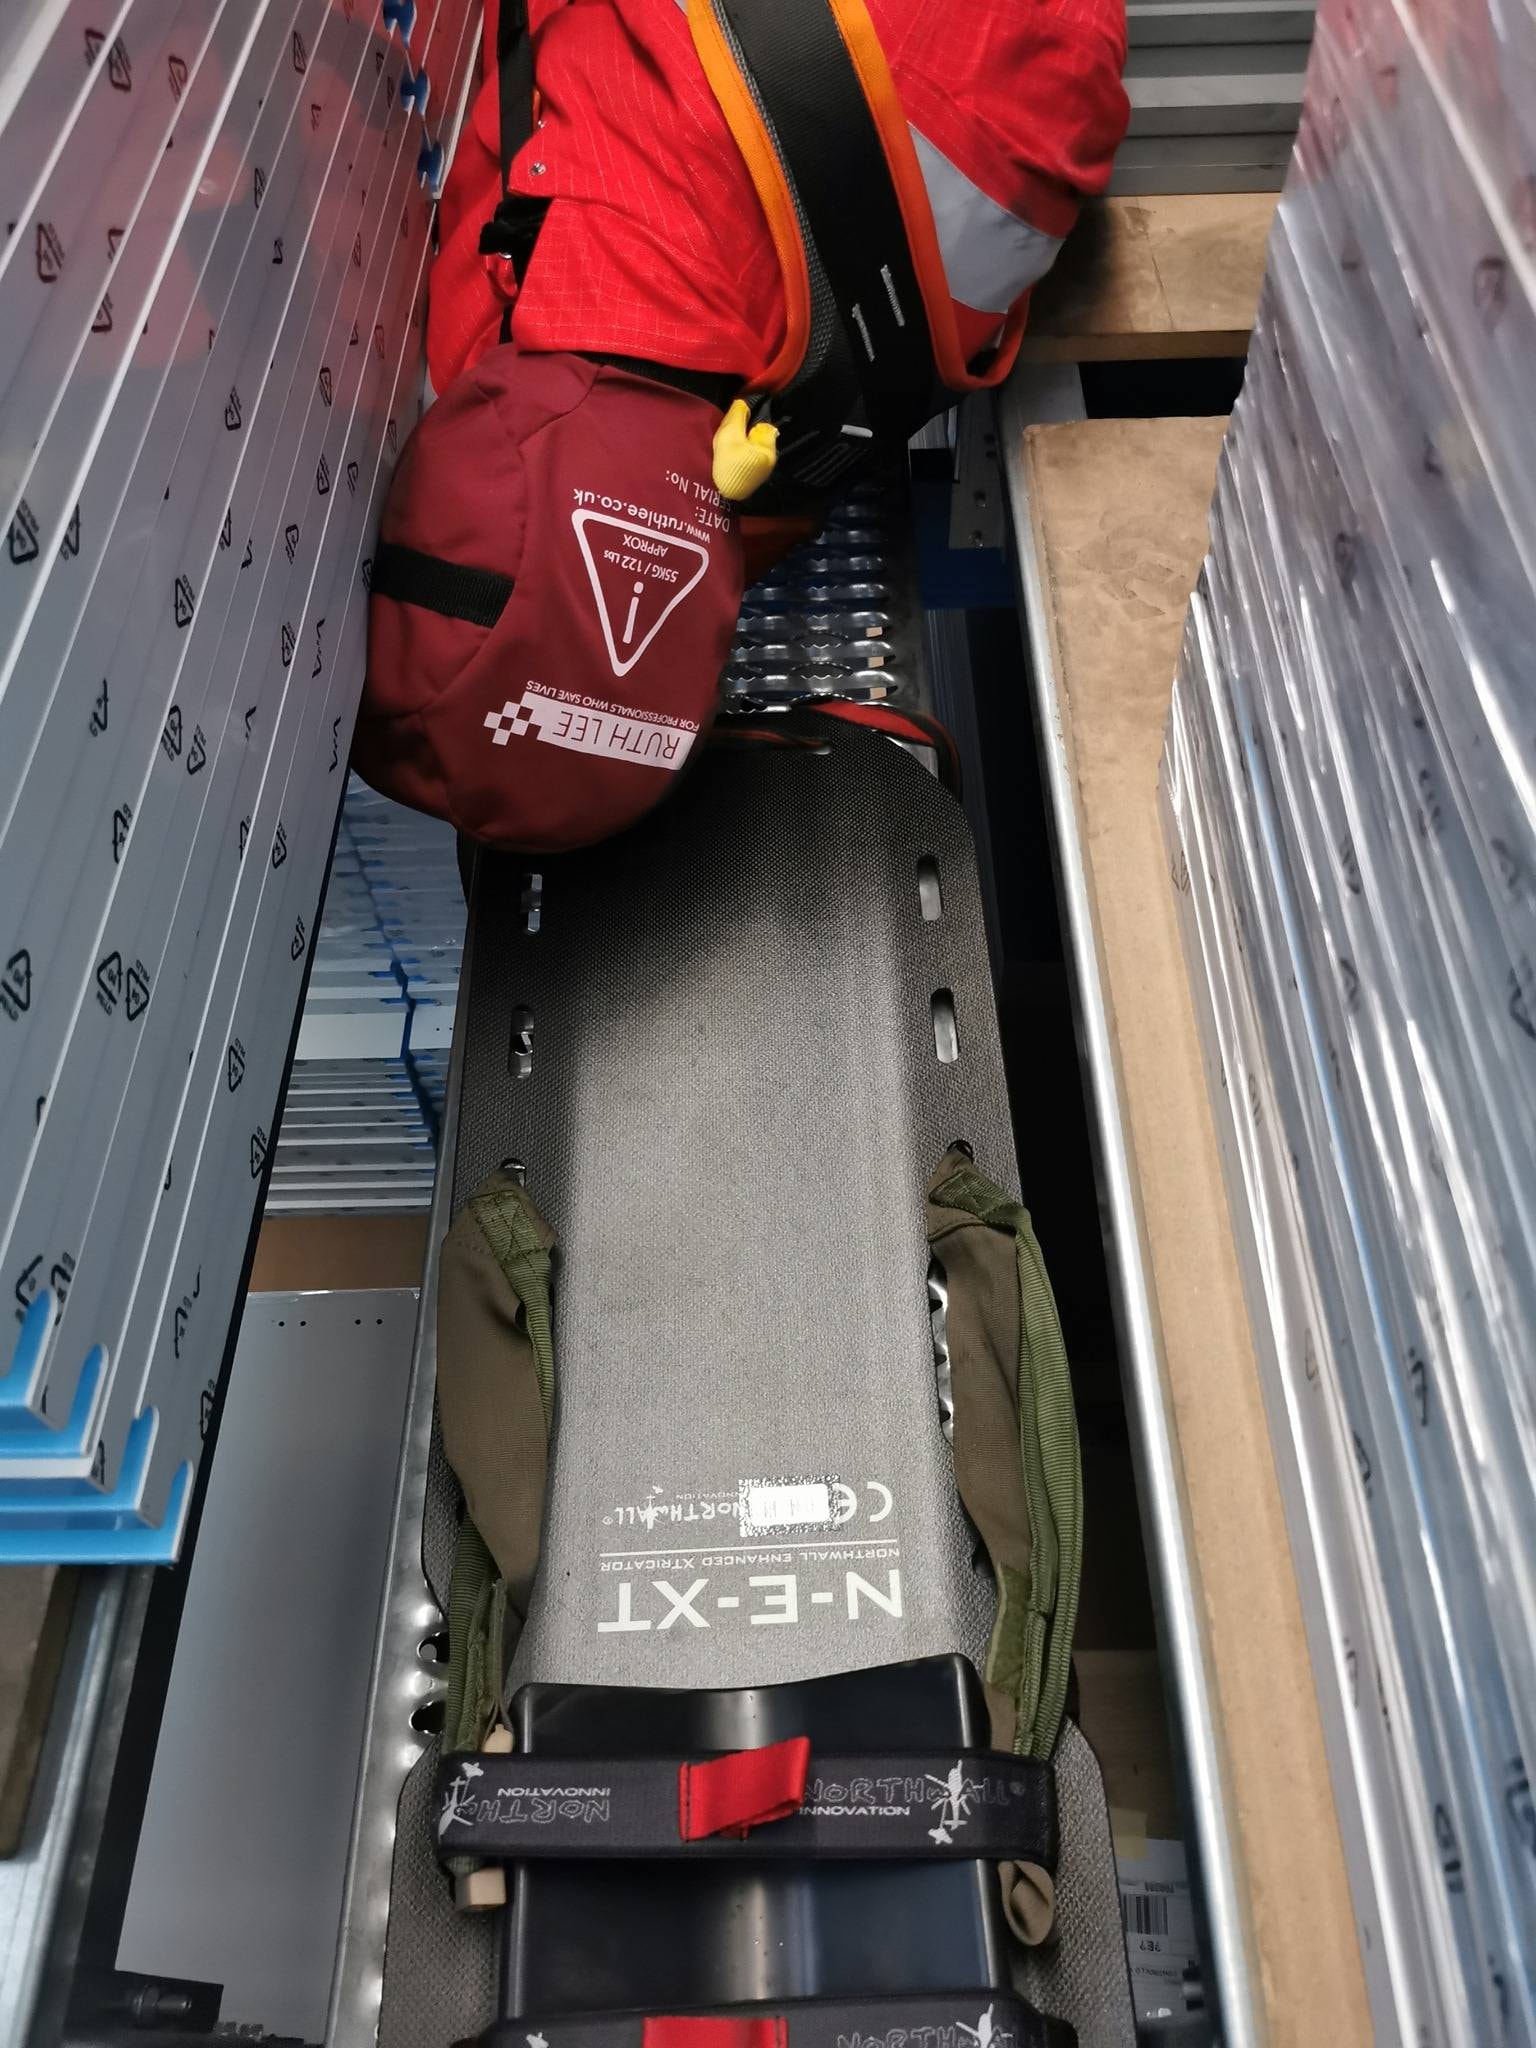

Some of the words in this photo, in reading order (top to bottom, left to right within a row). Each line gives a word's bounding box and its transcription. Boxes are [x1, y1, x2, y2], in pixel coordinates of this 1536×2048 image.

[665, 470, 689, 493] No:
[573, 488, 711, 544] www.ruthlee.co.uk
[694, 507, 730, 533] DATE:
[622, 534, 668, 557] APPROX
[621, 555, 643, 573] 122
[652, 563, 679, 583] 55KG
[526, 680, 557, 697] LIVES
[558, 690, 581, 704] SAVE
[582, 695, 609, 710] WHO
[610, 704, 678, 727] PROFESSIONALS
[679, 718, 699, 731] FOR
[551, 711, 603, 744] LEE
[608, 723, 680, 759] RUTH
[702, 1552, 792, 1566] ENHANCED
[799, 1548, 899, 1562] NORTHWALL
[597, 1569, 902, 1632] N-E-XT
[497, 1787, 610, 1797] INNOVATION
[799, 1806, 910, 1816] INNOVATION
